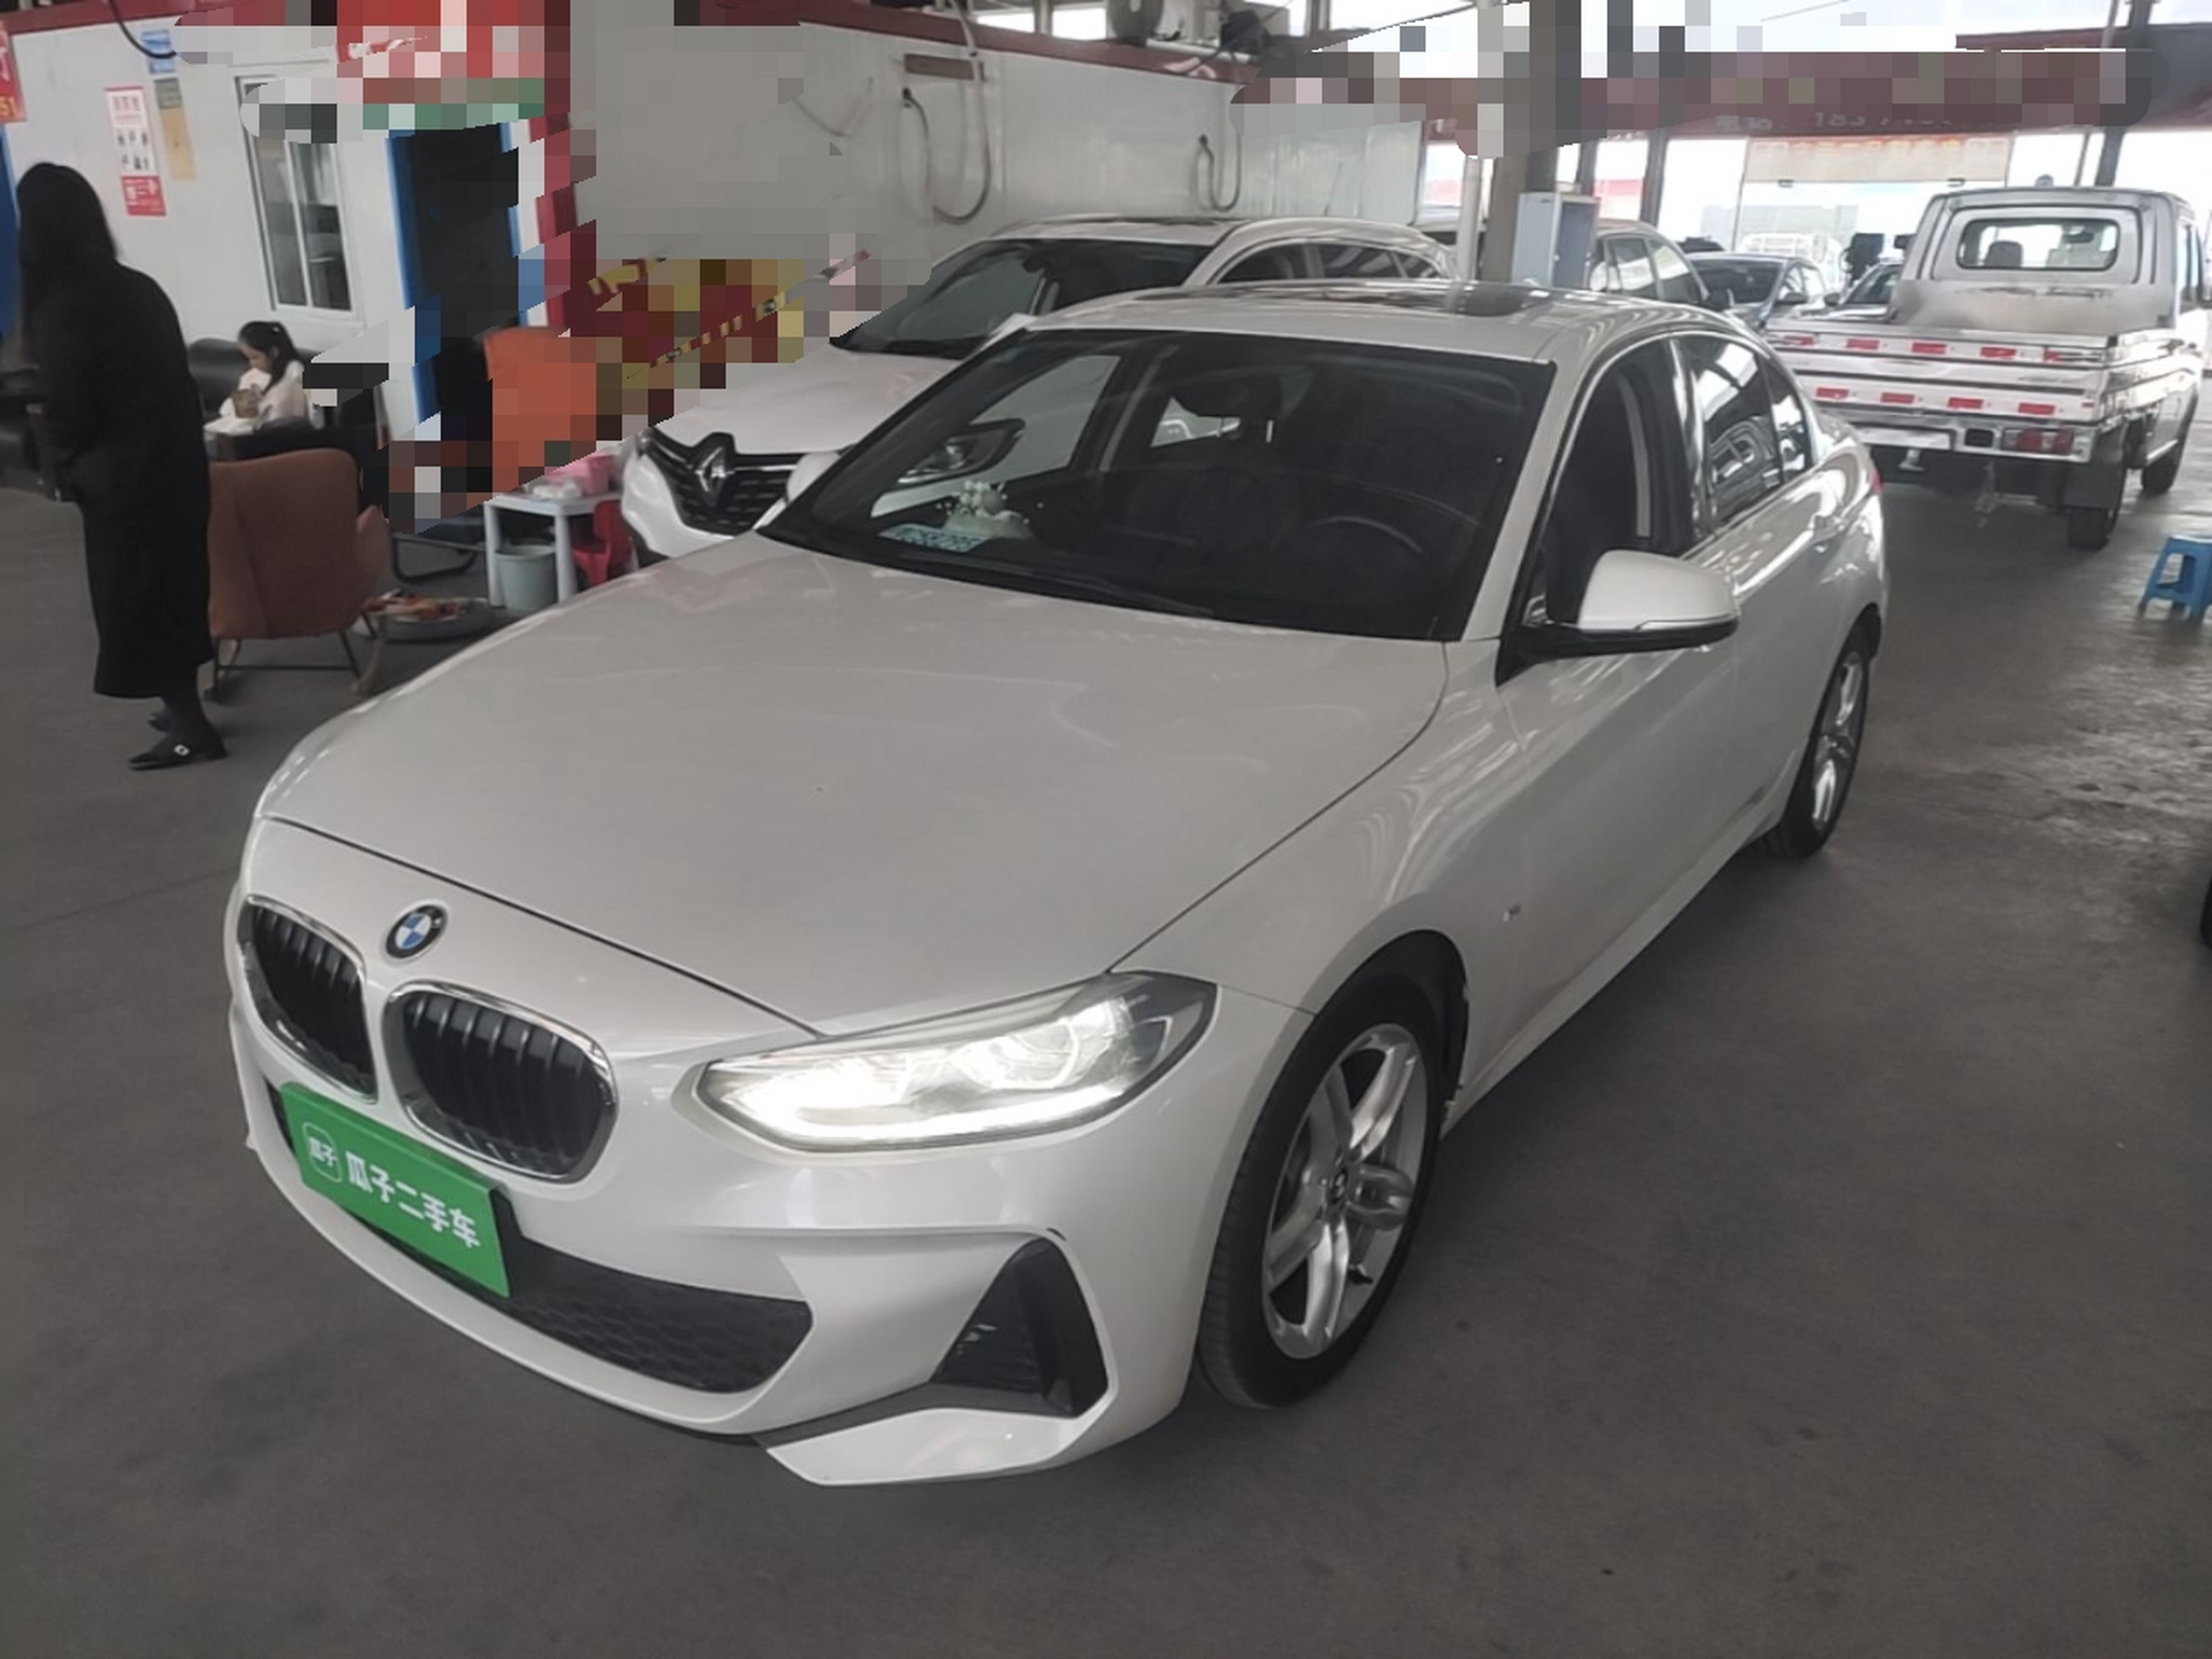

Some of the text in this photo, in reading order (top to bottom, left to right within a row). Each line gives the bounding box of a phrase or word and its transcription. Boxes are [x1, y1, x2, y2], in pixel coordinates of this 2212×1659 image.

[346, 1150, 480, 1247] 瓜子二手车
